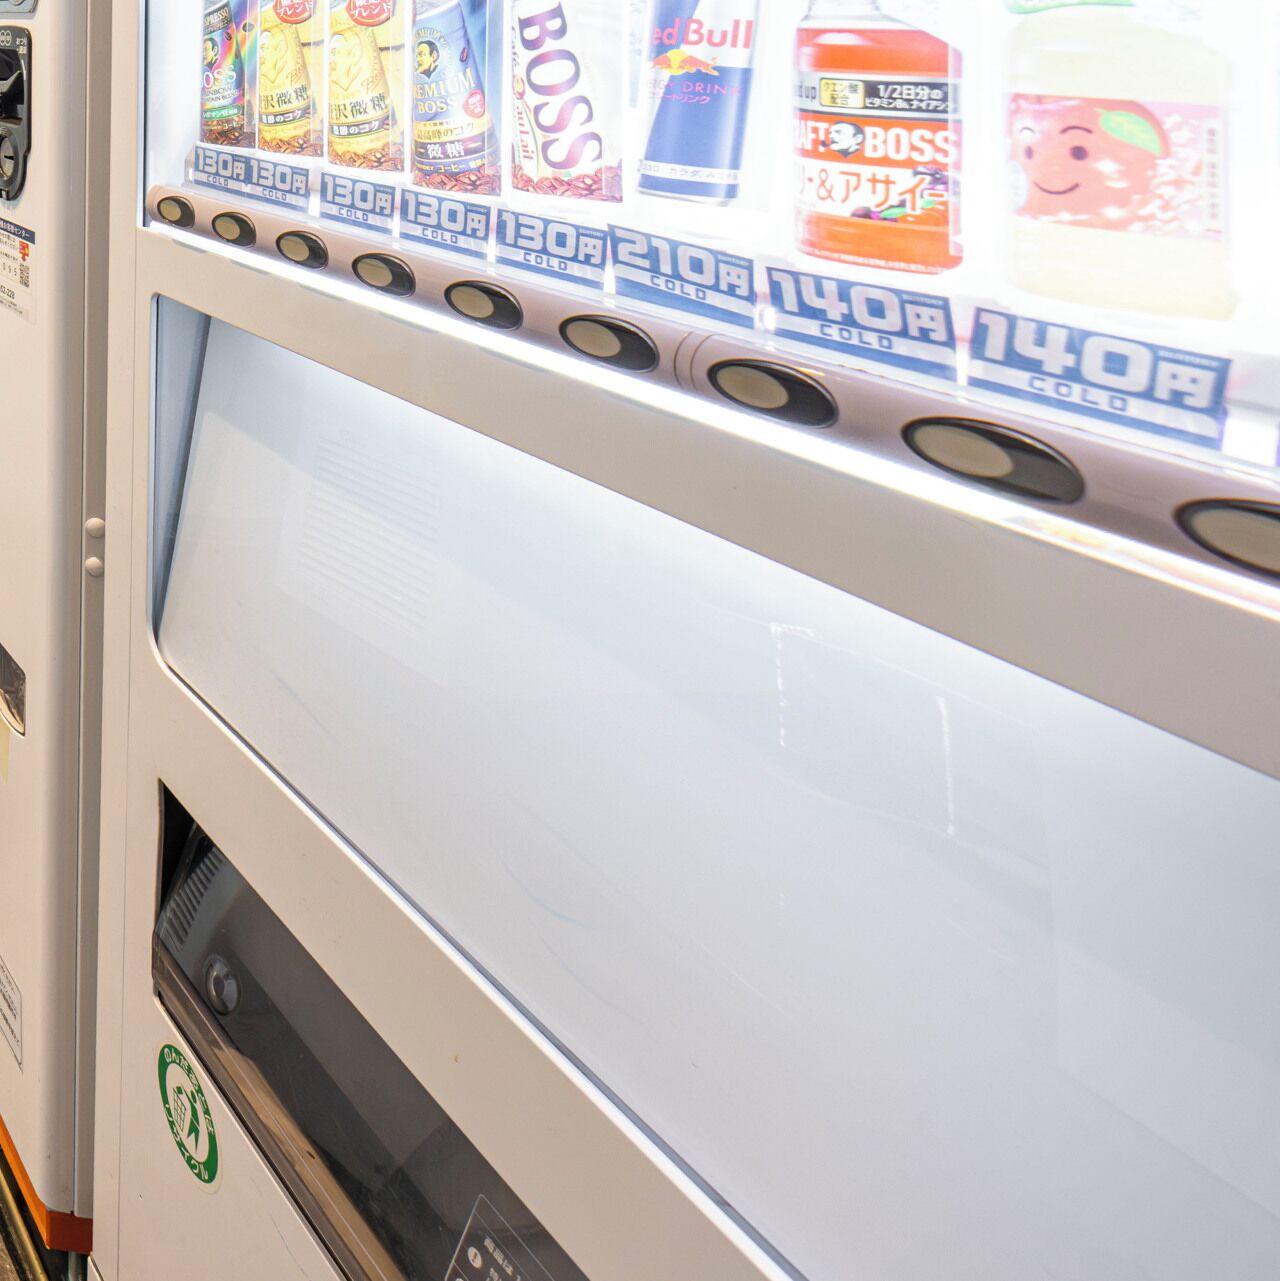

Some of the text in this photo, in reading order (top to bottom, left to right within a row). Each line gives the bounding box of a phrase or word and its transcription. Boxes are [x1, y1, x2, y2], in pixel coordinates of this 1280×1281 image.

[205, 7, 230, 26] PRESSO
[278, 1, 314, 18] ブレンド
[351, 0, 393, 20] ブレンド
[651, 16, 754, 50] ed Bull
[201, 65, 237, 90] OSS
[416, 69, 476, 100] EMIUM
[517, 1, 604, 171] BOSS
[682, 80, 741, 98] DRINK
[876, 82, 942, 102] 1/2日分の
[417, 96, 460, 115] BOSS
[427, 142, 466, 160] 微糖
[864, 126, 959, 163] BOSS
[197, 149, 245, 180] 130円
[248, 159, 308, 195] 130円
[206, 173, 230, 188] COLD
[261, 186, 288, 202] COLD
[324, 173, 392, 215] 130円
[338, 205, 370, 223] COLD
[405, 191, 488, 239] 130円
[421, 226, 459, 246] COLD
[502, 211, 604, 267] 130円
[522, 251, 569, 273] COLD
[616, 225, 750, 299] 210円
[650, 272, 710, 303] COLD
[771, 269, 949, 350] 140円
[818, 322, 896, 353] COLD
[980, 312, 1216, 410] 140円
[1027, 374, 1129, 414] COLD
